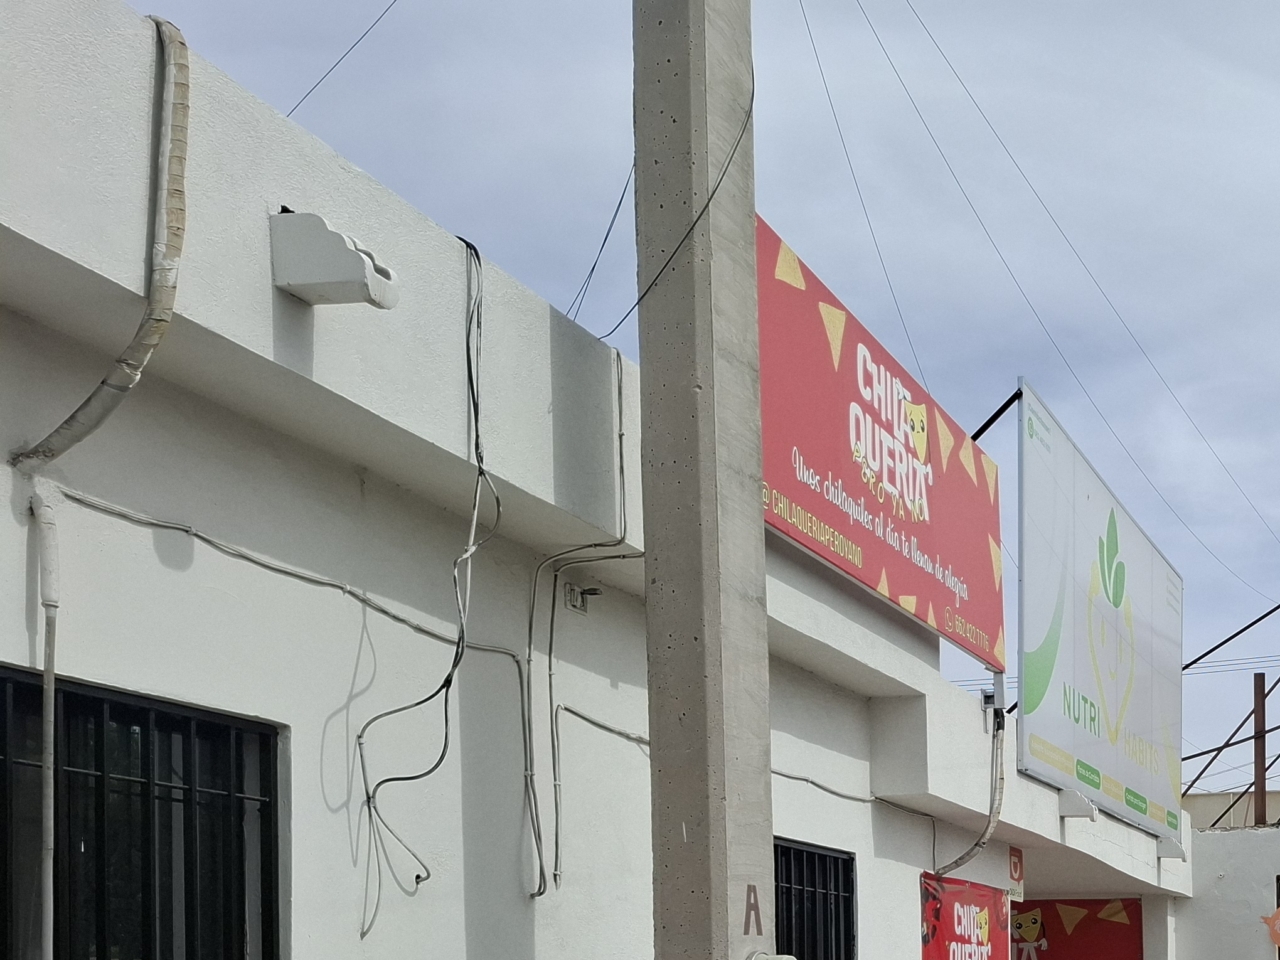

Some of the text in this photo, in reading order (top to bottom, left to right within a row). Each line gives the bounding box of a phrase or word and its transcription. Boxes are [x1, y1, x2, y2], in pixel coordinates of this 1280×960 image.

[792, 446, 821, 494] Unos
[823, 471, 873, 531] chilaquiles
[875, 512, 885, 540] al
[901, 533, 911, 558] te
[911, 535, 934, 575] llenan
[935, 555, 944, 583] de
[955, 614, 966, 637] 662
[1063, 681, 1101, 738] NUTRI
[1124, 727, 1159, 776] HABITS
[743, 883, 764, 937] A
